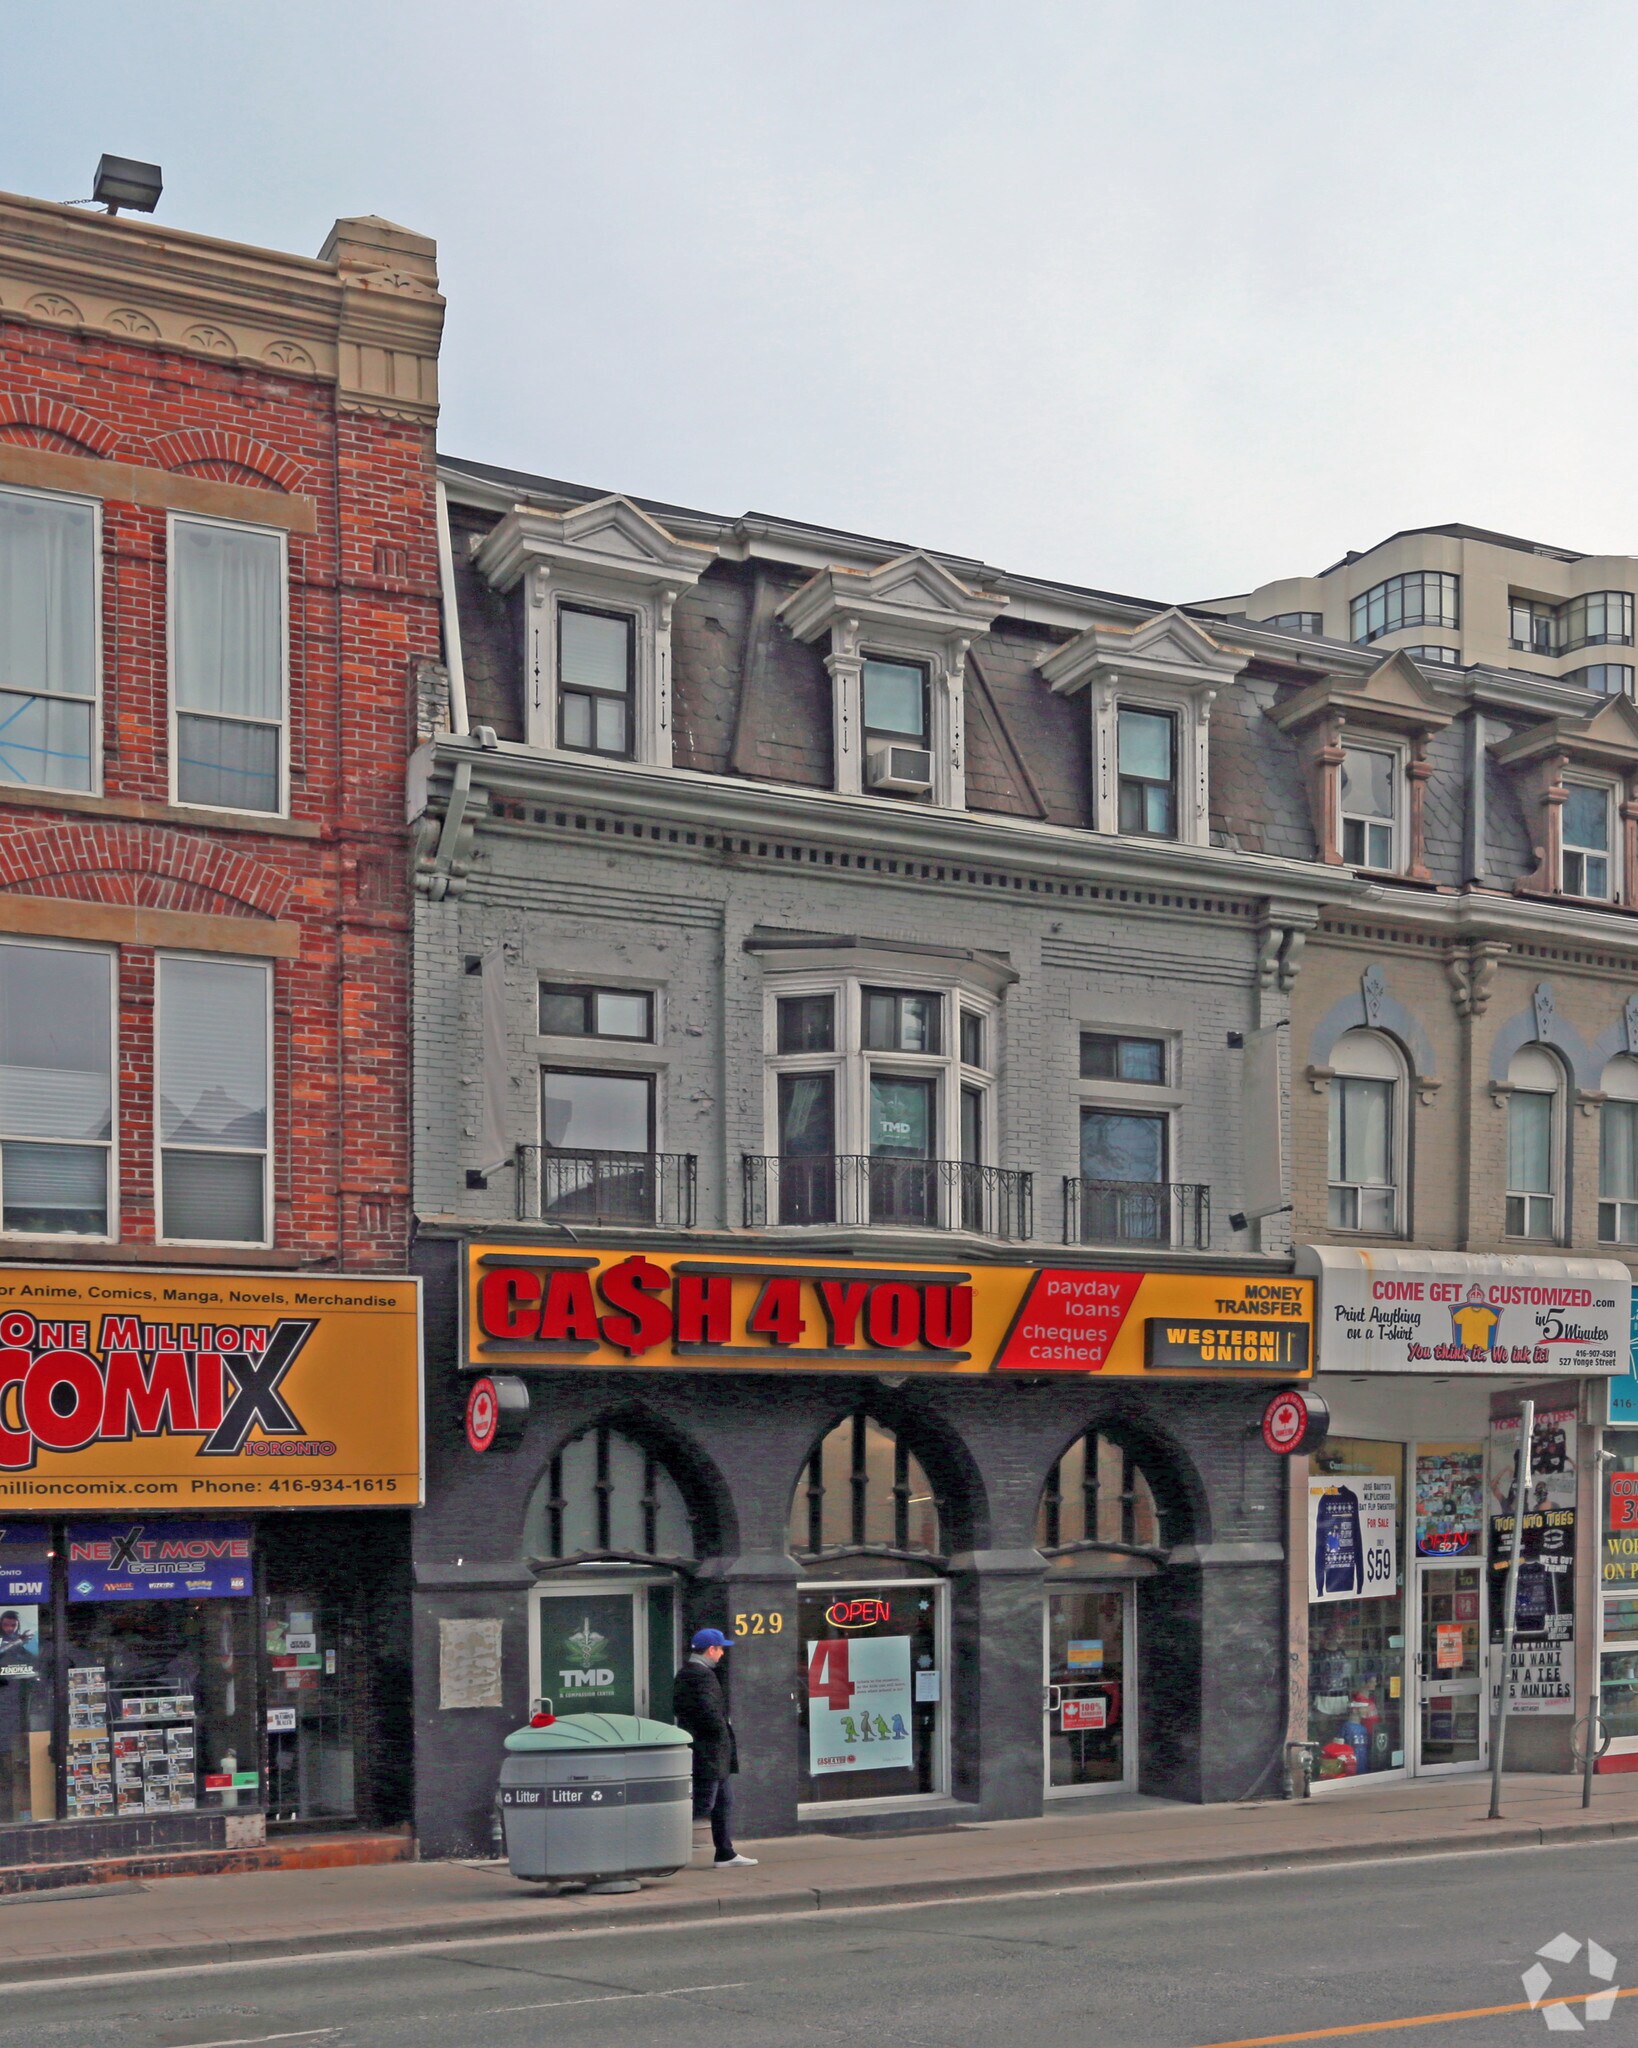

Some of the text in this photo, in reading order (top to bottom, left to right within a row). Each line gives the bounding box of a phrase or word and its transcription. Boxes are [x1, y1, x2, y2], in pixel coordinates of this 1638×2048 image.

[880, 1121, 910, 1133] TMD
[20, 1285, 82, 1299] Anime,
[88, 1286, 157, 1301] Comics,
[163, 1289, 223, 1303] Manga,
[229, 1291, 289, 1305] Novels,
[294, 1293, 396, 1306] Merchandise
[1048, 1281, 1120, 1298] payday
[1245, 1285, 1303, 1300] MONEY
[1372, 1281, 1424, 1301] COME
[1430, 1283, 1463, 1302] GET
[480, 1256, 973, 1355] CA$H 4 YOU
[1066, 1301, 1121, 1317] loans
[1216, 1299, 1302, 1316] TRANSFER
[1334, 1305, 1421, 1327] Print Anything
[1535, 1308, 1608, 1340] in 5 Minutes
[0, 1312, 268, 1352] ONE MILLION
[1023, 1325, 1107, 1342] cheques
[1167, 1328, 1274, 1345] WESTERN
[1347, 1324, 1413, 1340] on a T-shirt
[1030, 1345, 1101, 1360] cashed
[1201, 1345, 1274, 1361] UNION
[1408, 1343, 1431, 1361] You
[1434, 1342, 1468, 1361] think
[1491, 1346, 1508, 1362] We
[1511, 1346, 1531, 1364] ink
[1533, 1346, 1549, 1363] it!
[1576, 1350, 1616, 1358] 416-907-4581
[1559, 1358, 1616, 1367] 527 Yonge Street
[244, 1441, 336, 1456] TORONTO
[191, 1480, 262, 1493] Phone:
[269, 1479, 397, 1493] 416-934-1615
[1378, 1518, 1389, 1528] SALE
[70, 1527, 249, 1570] NEXT MOVE
[1439, 1542, 1458, 1553] 527
[1367, 1548, 1391, 1582] $59
[1604, 1562, 1626, 1580] ON
[9, 1582, 43, 1594] IDW
[832, 1602, 891, 1622] OPEN
[735, 1612, 783, 1636] 529
[1510, 1652, 1561, 1666] OU WANT
[559, 1668, 615, 1688] TMD
[808, 1639, 855, 1710] 4
[1537, 1668, 1561, 1682] TEE
[1510, 1684, 1517, 1697] 5
[1521, 1683, 1570, 1698] MINUTES
[516, 1790, 583, 1803] Litter Litter
